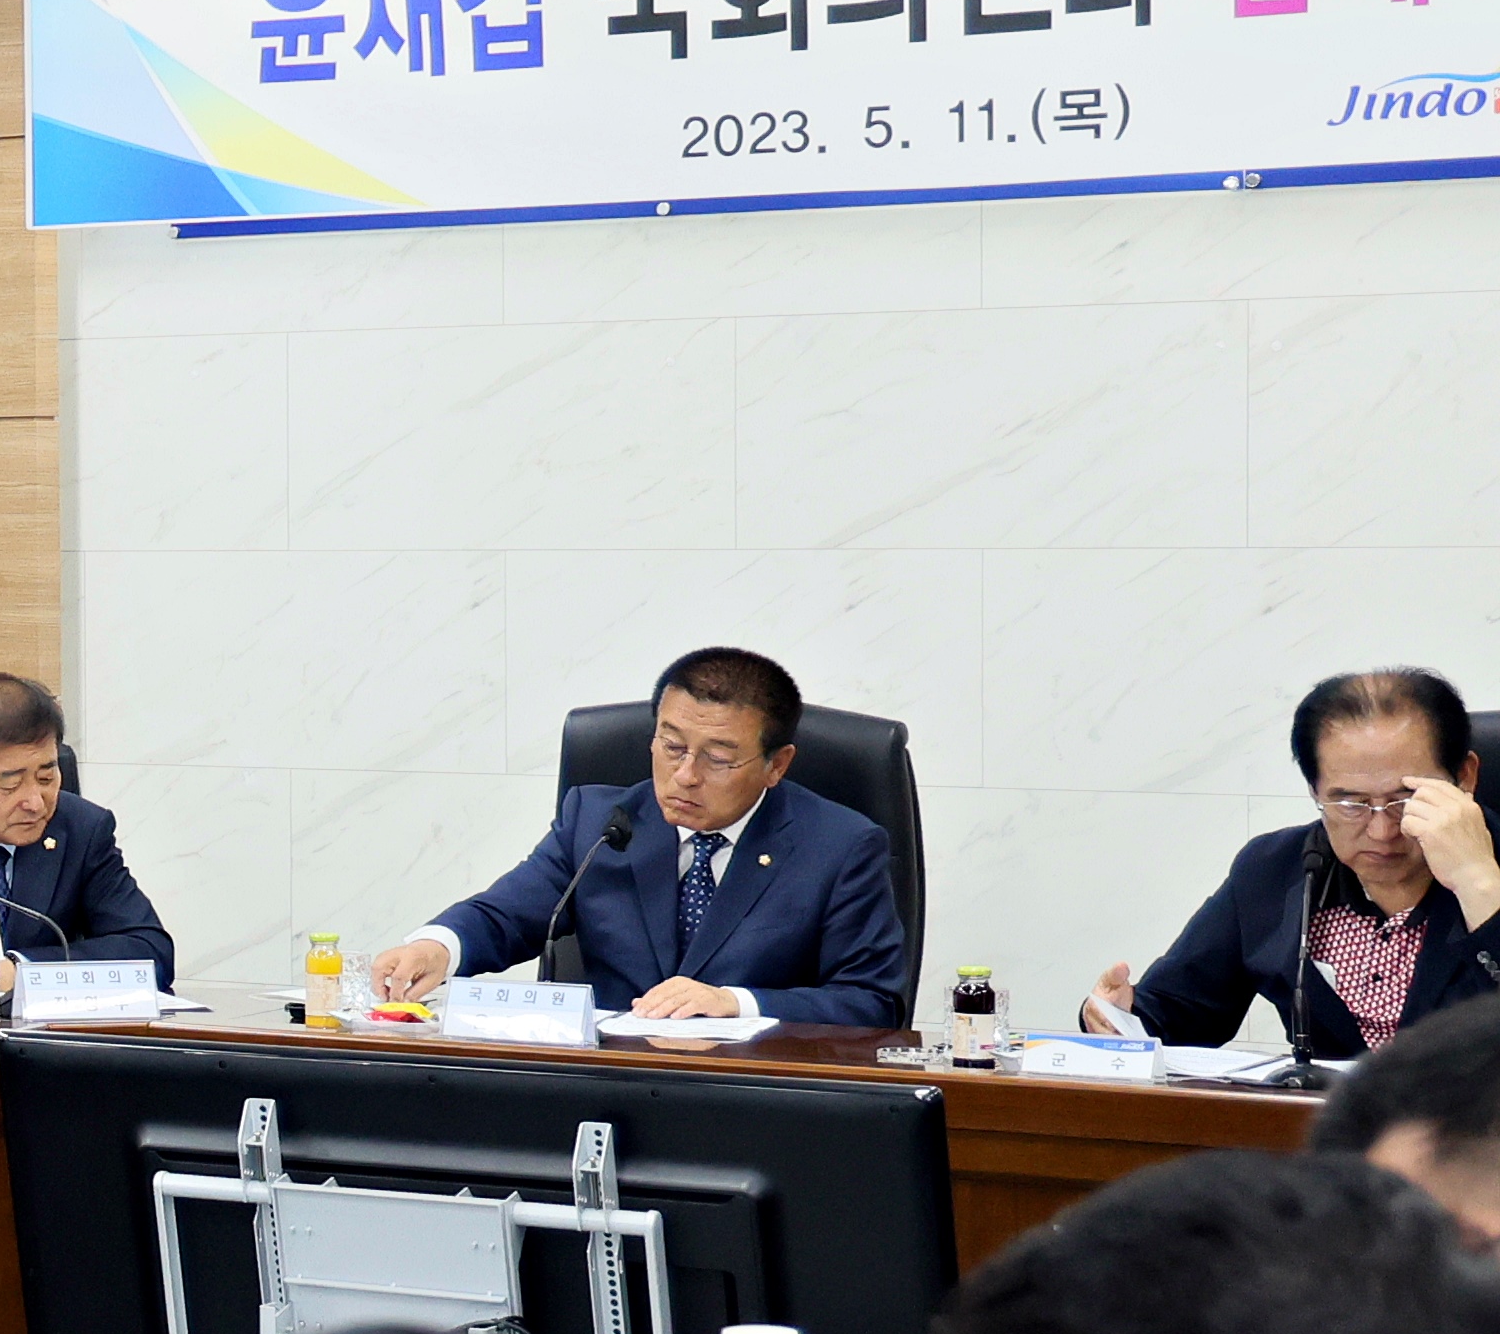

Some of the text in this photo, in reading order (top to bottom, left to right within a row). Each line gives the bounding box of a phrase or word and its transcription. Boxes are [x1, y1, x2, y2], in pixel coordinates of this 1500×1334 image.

[1326, 82, 1487, 126] Jindo
[681, 109, 827, 158] 2023.
[863, 105, 910, 149] 5.
